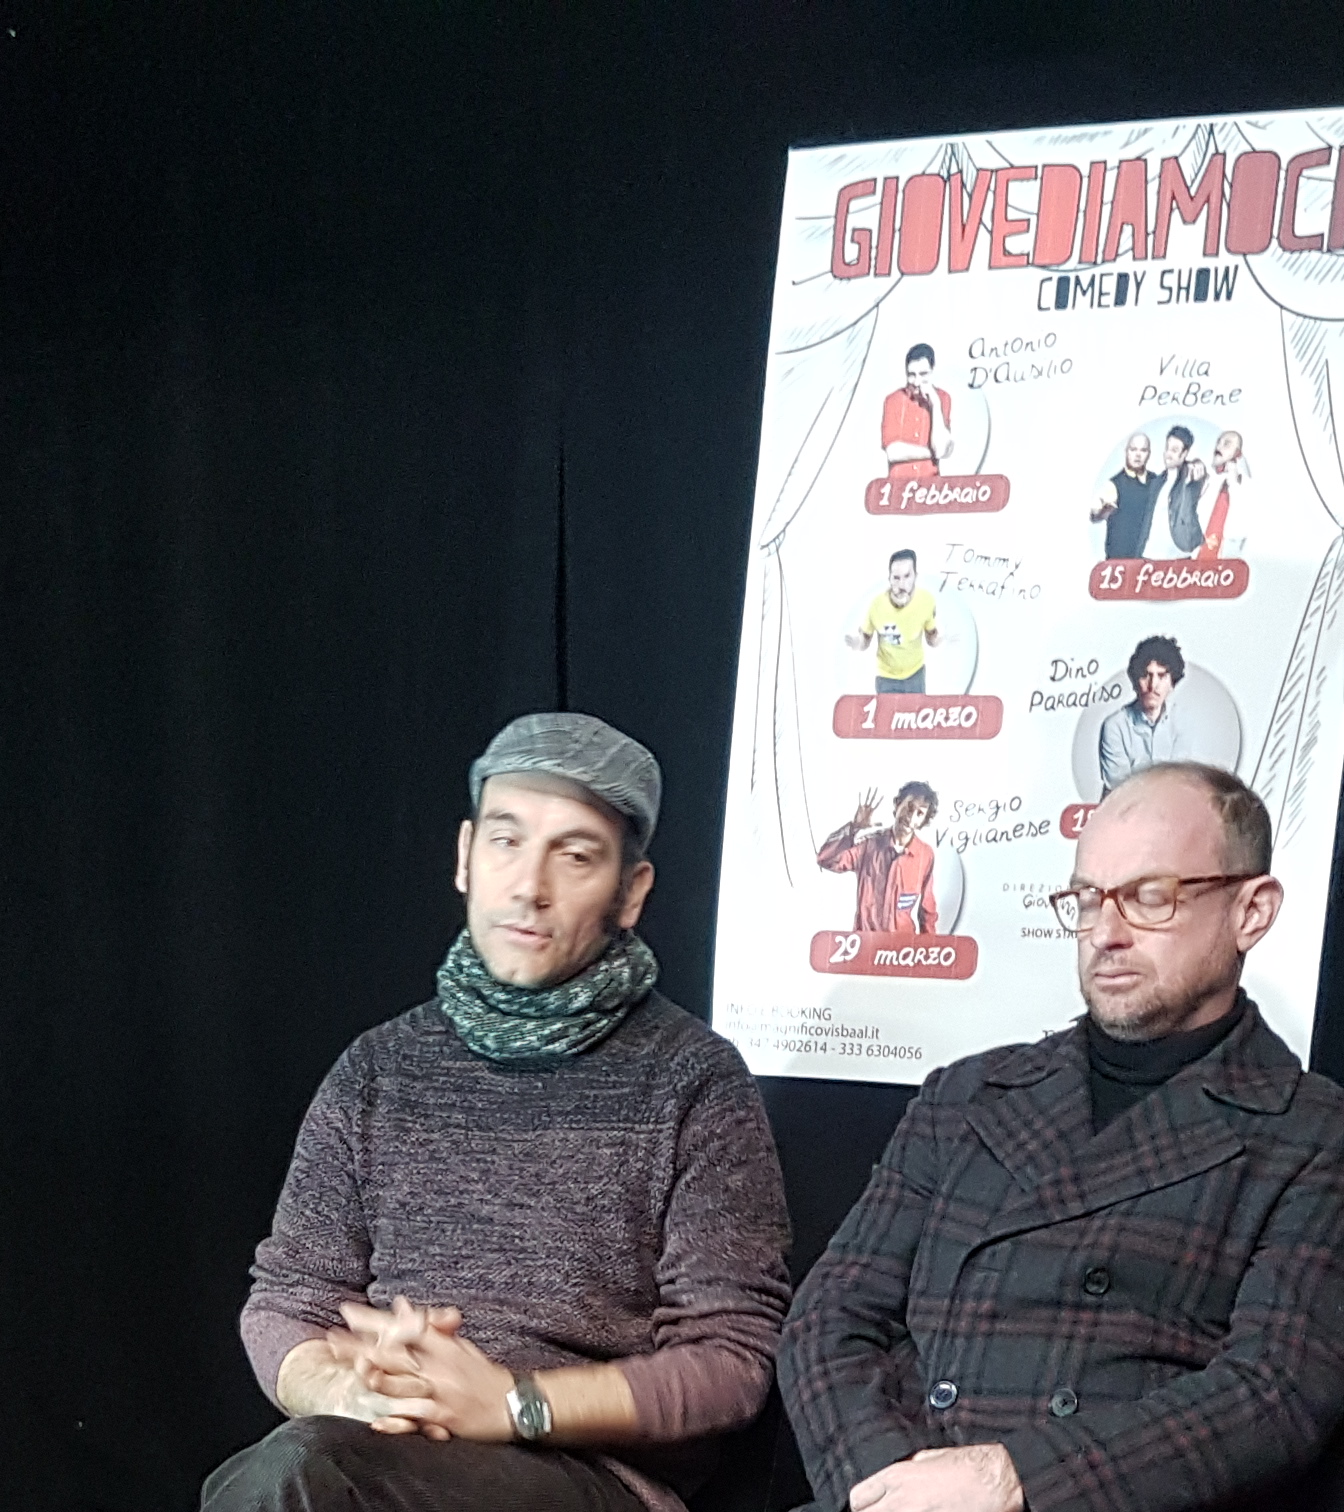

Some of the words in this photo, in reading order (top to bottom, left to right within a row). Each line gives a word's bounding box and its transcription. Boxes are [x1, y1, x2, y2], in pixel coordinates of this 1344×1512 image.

[1036, 270, 1146, 311] COMEDY
[1157, 264, 1240, 305] SHOW
[1158, 354, 1212, 378] Villa
[879, 483, 892, 507] 1
[901, 481, 992, 510] febbraio
[1098, 564, 1123, 590] 15
[1135, 563, 1235, 593] febbraio
[1049, 658, 1100, 682] Dino
[1029, 683, 1123, 714] Paradiso
[860, 700, 878, 730] 1
[890, 704, 978, 731] marzo
[949, 795, 1023, 823] Sergio
[1020, 927, 1054, 939] SHOW
[829, 934, 861, 964] 29
[873, 946, 957, 967] marzo
[838, 1042, 863, 1056] 333
[865, 1044, 923, 1060] 6304056
